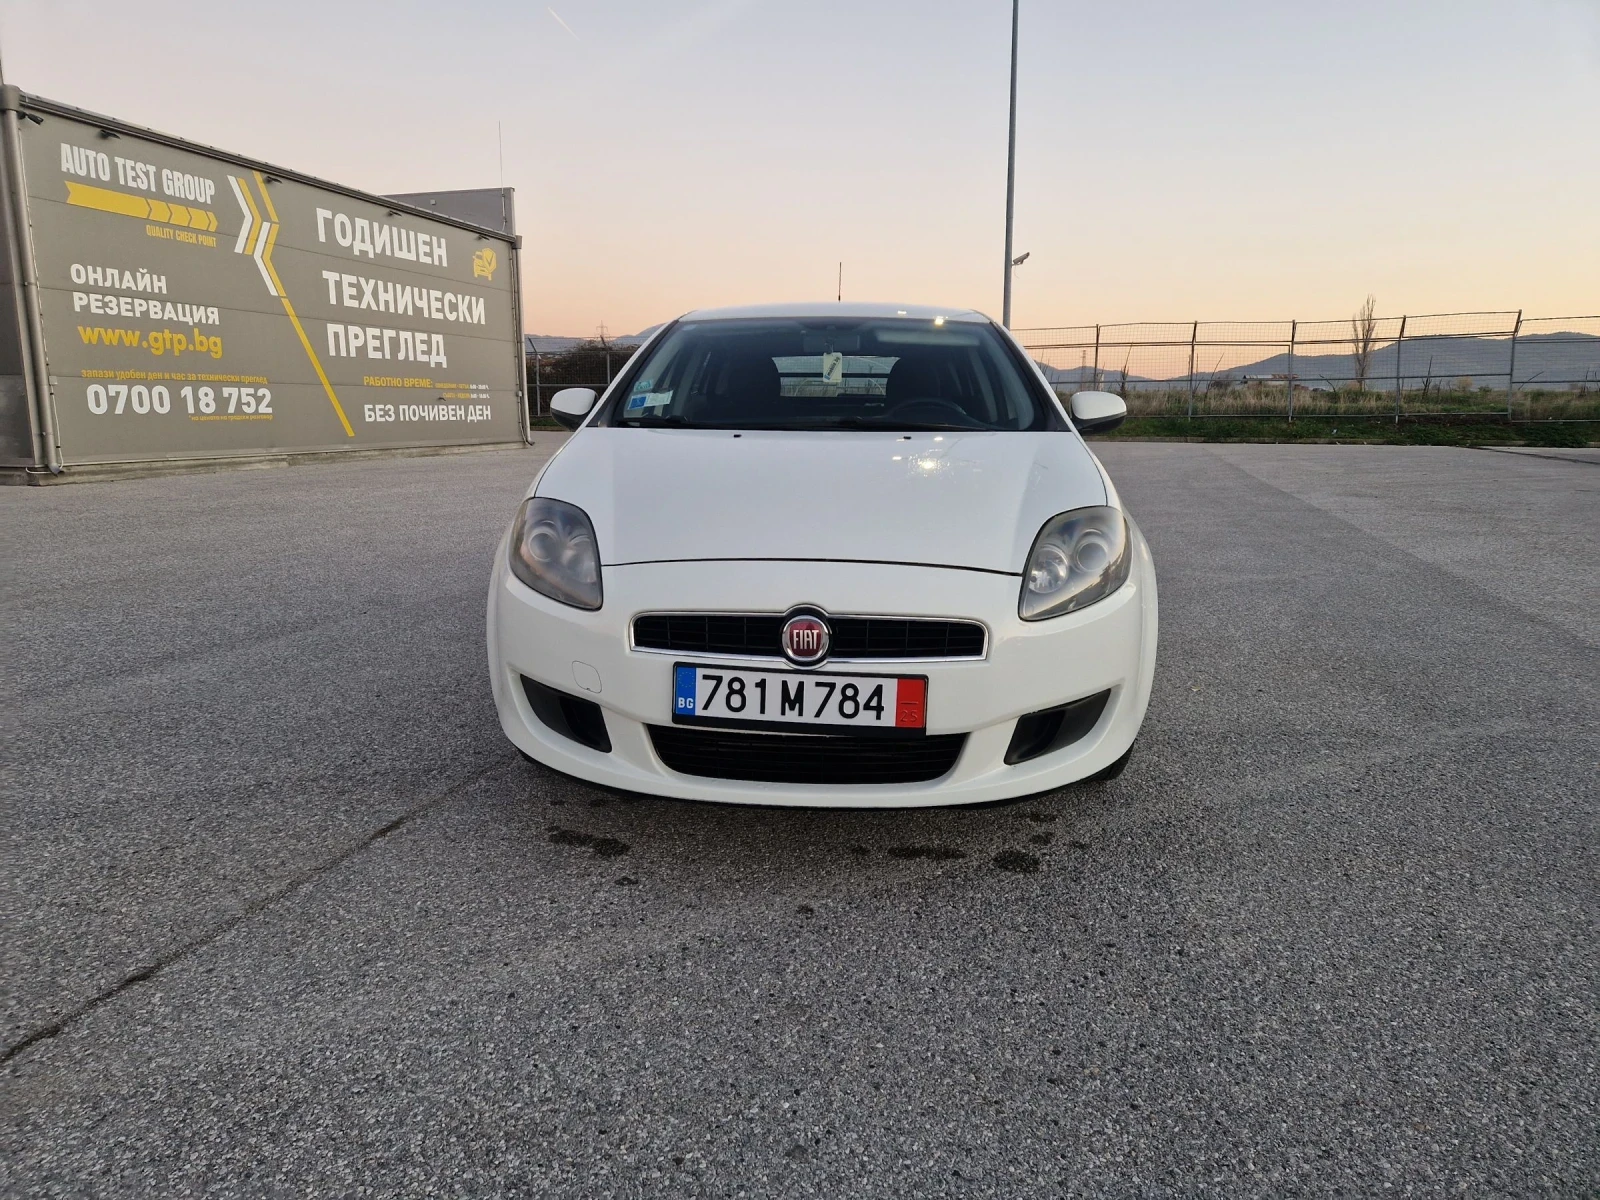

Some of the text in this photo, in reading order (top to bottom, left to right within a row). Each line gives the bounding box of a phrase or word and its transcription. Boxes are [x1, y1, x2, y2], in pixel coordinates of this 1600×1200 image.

[61, 143, 215, 204] AUTO TEST GROUP
[146, 224, 216, 247] QUALITY CHECK POINT
[316, 208, 448, 267] ГОДИШЕН
[70, 264, 167, 294] ОНЛАЙН
[73, 292, 219, 325] РЕЗЕРВАЦИЯ
[322, 270, 485, 324] ТЕХНИЧЕСКИ
[78, 326, 223, 359] www.gtp.bg
[327, 323, 447, 368] ПРЕГЛЕД
[81, 369, 114, 378] запази
[116, 369, 146, 380] удобен
[148, 371, 162, 380] ден
[171, 372, 186, 380] час
[198, 373, 240, 382] технически
[241, 375, 268, 384] преглед
[363, 376, 402, 387] РАБОТНО
[404, 378, 433, 388] ВРЕМЕ:
[87, 384, 272, 414] 0700 18 752
[364, 404, 491, 423] БЕЗ ПОЧИВЕН ДЕН
[793, 629, 819, 650] FIAT
[678, 674, 884, 721] BG 781 M 784
[900, 709, 918, 723] 25
